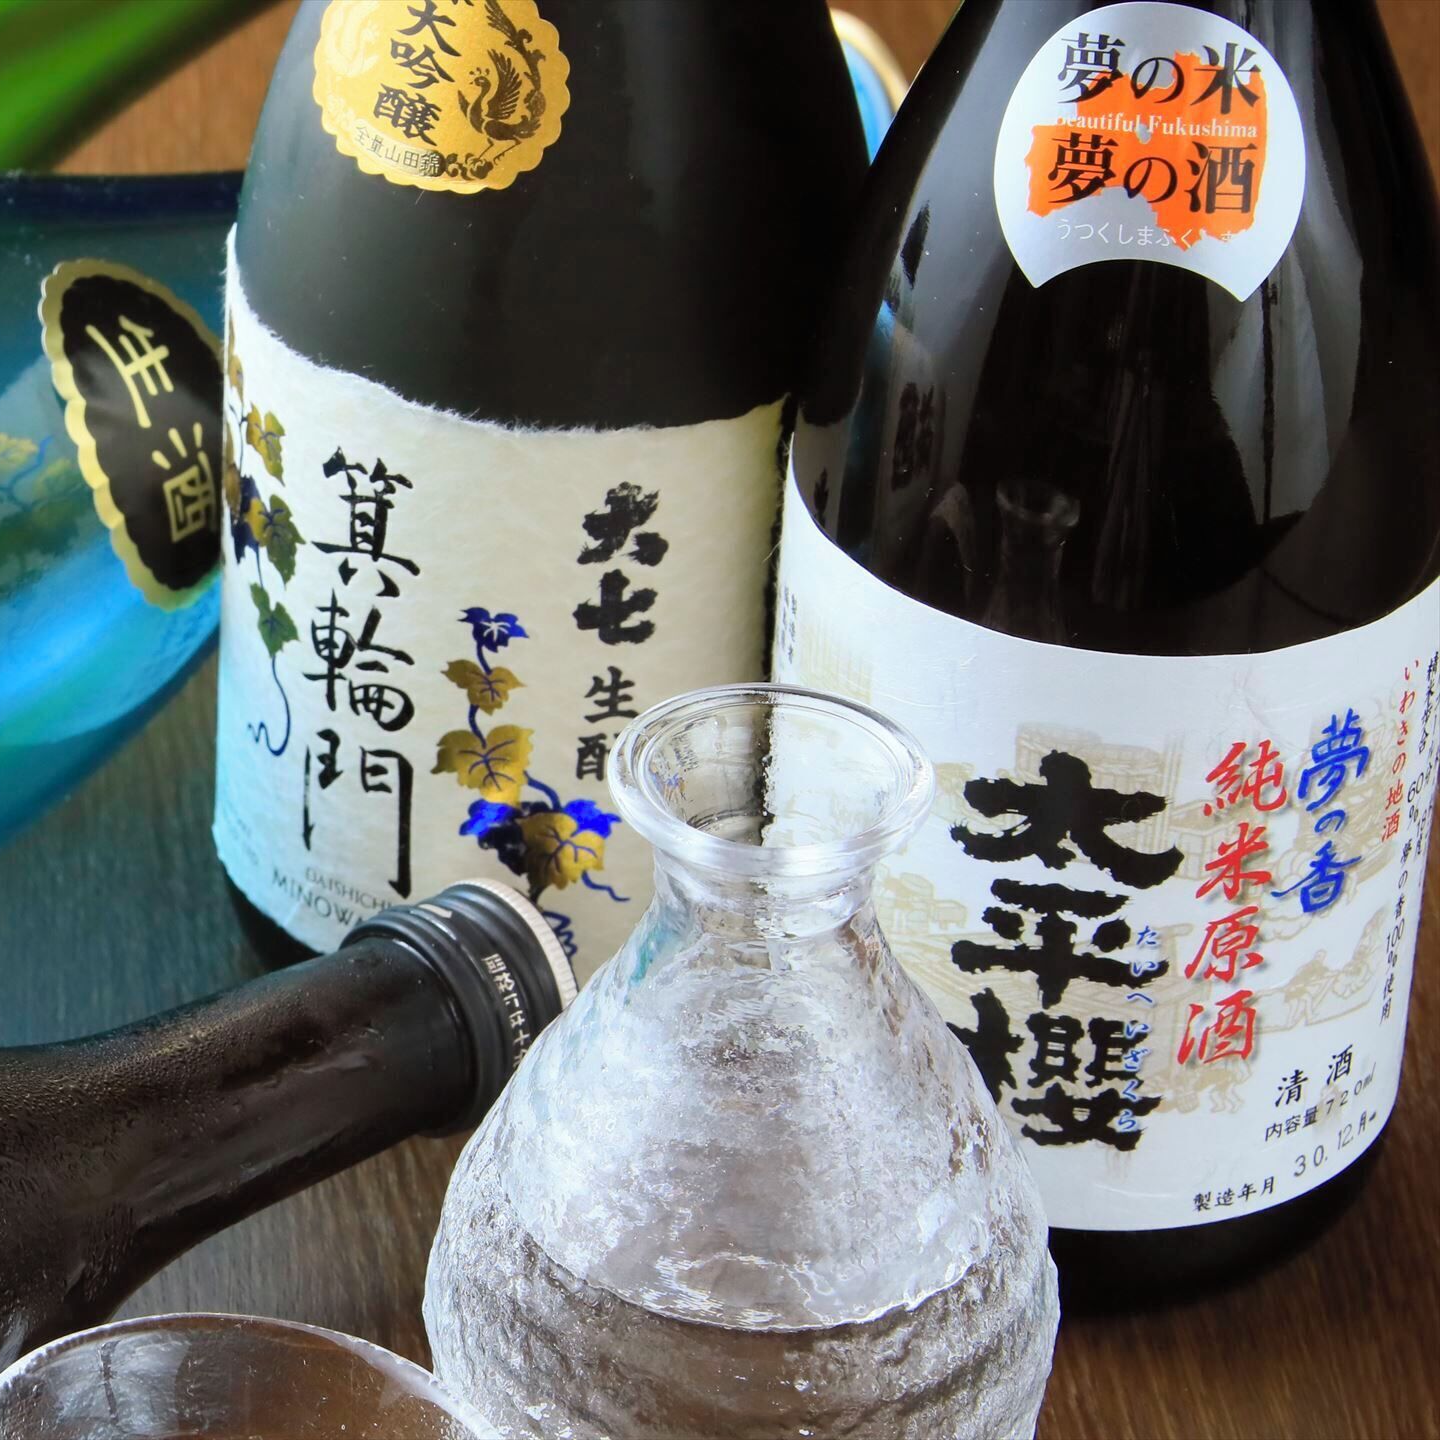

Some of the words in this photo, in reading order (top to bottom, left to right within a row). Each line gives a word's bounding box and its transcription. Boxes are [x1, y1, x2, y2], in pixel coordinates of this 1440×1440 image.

[354, 122, 441, 179] 全量山田錦
[1058, 32, 1261, 114] 夢の米
[1148, 115, 1258, 137] Fukushima
[1047, 132, 1258, 214] 夢の酒
[85, 315, 218, 543] 生酒
[573, 481, 670, 646] 大七
[302, 446, 421, 900] 箕輪門
[1380, 659, 1420, 843] いわきの地酒
[1177, 740, 1288, 1066] 純米原酒
[1271, 709, 1369, 914] 夢の香
[1116, 926, 1161, 1133] たいへいざくら
